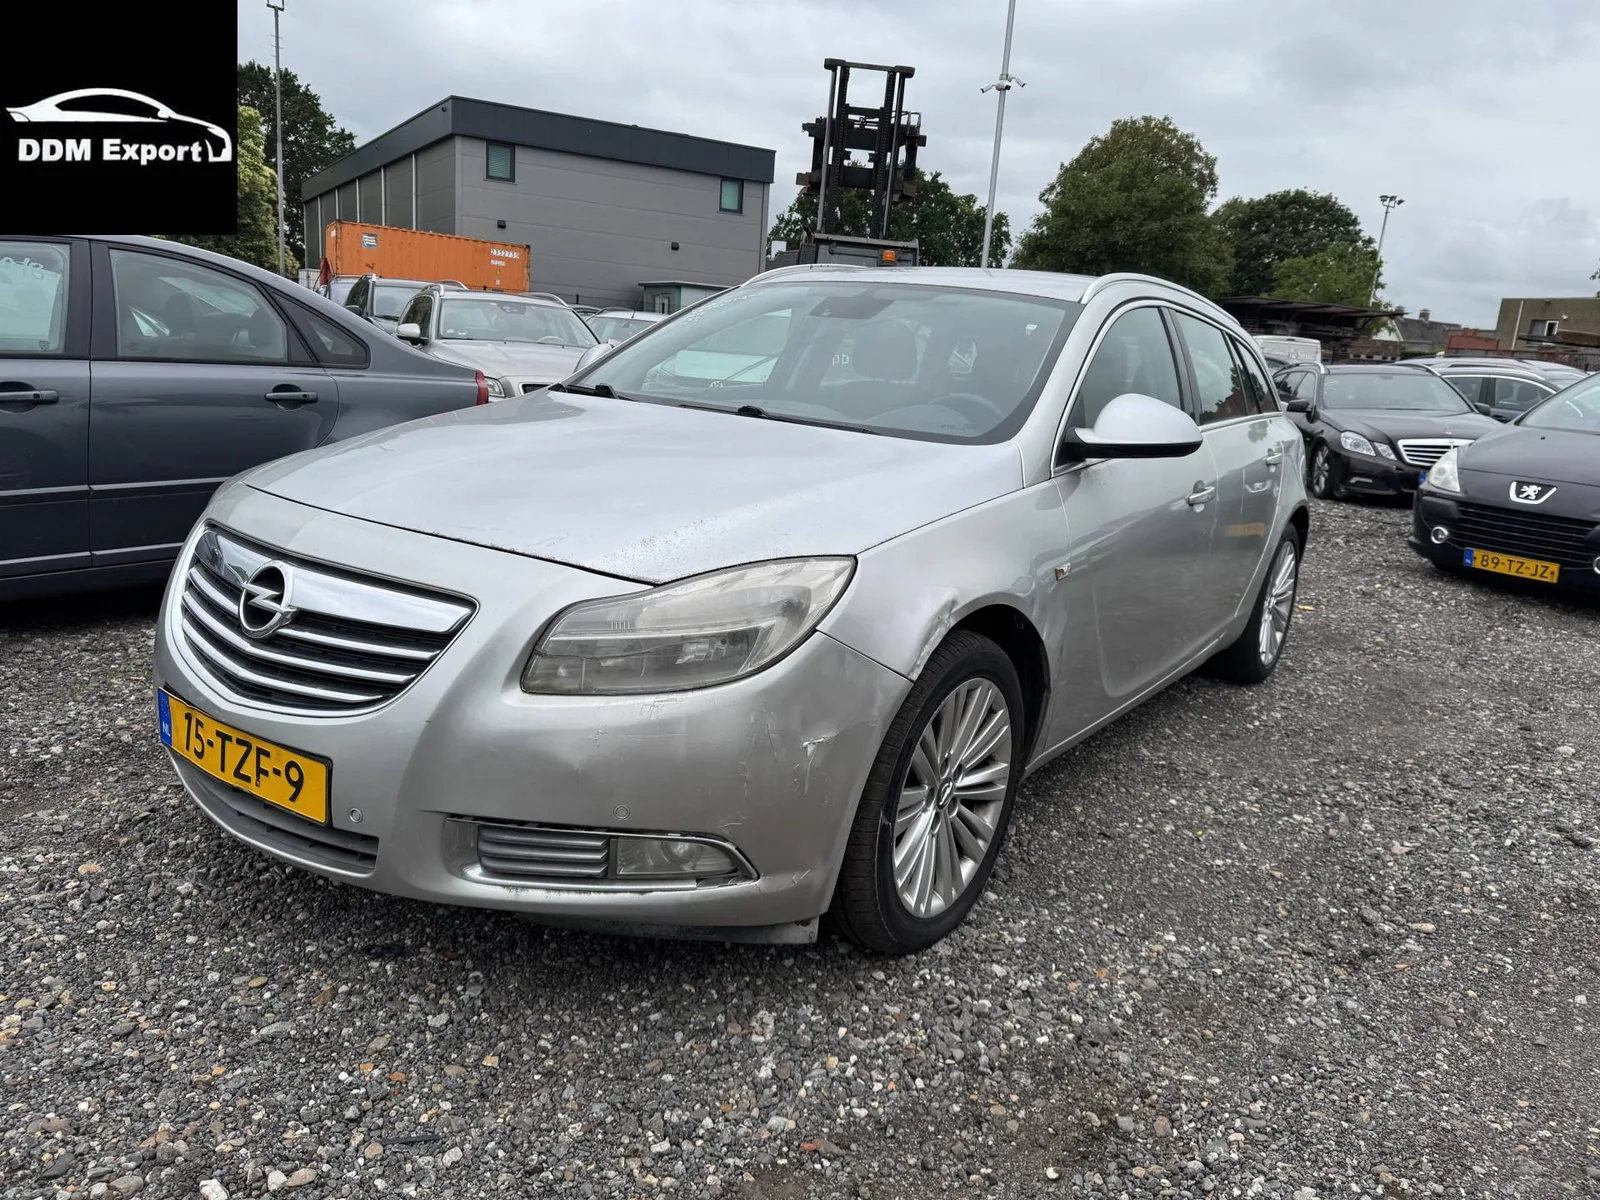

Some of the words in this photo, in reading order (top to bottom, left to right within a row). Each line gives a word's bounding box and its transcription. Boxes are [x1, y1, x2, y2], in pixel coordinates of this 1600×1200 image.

[1480, 554, 1550, 579] 89-TZ-JZ
[162, 721, 171, 738] NL
[184, 711, 305, 803] 15-TZF-9
